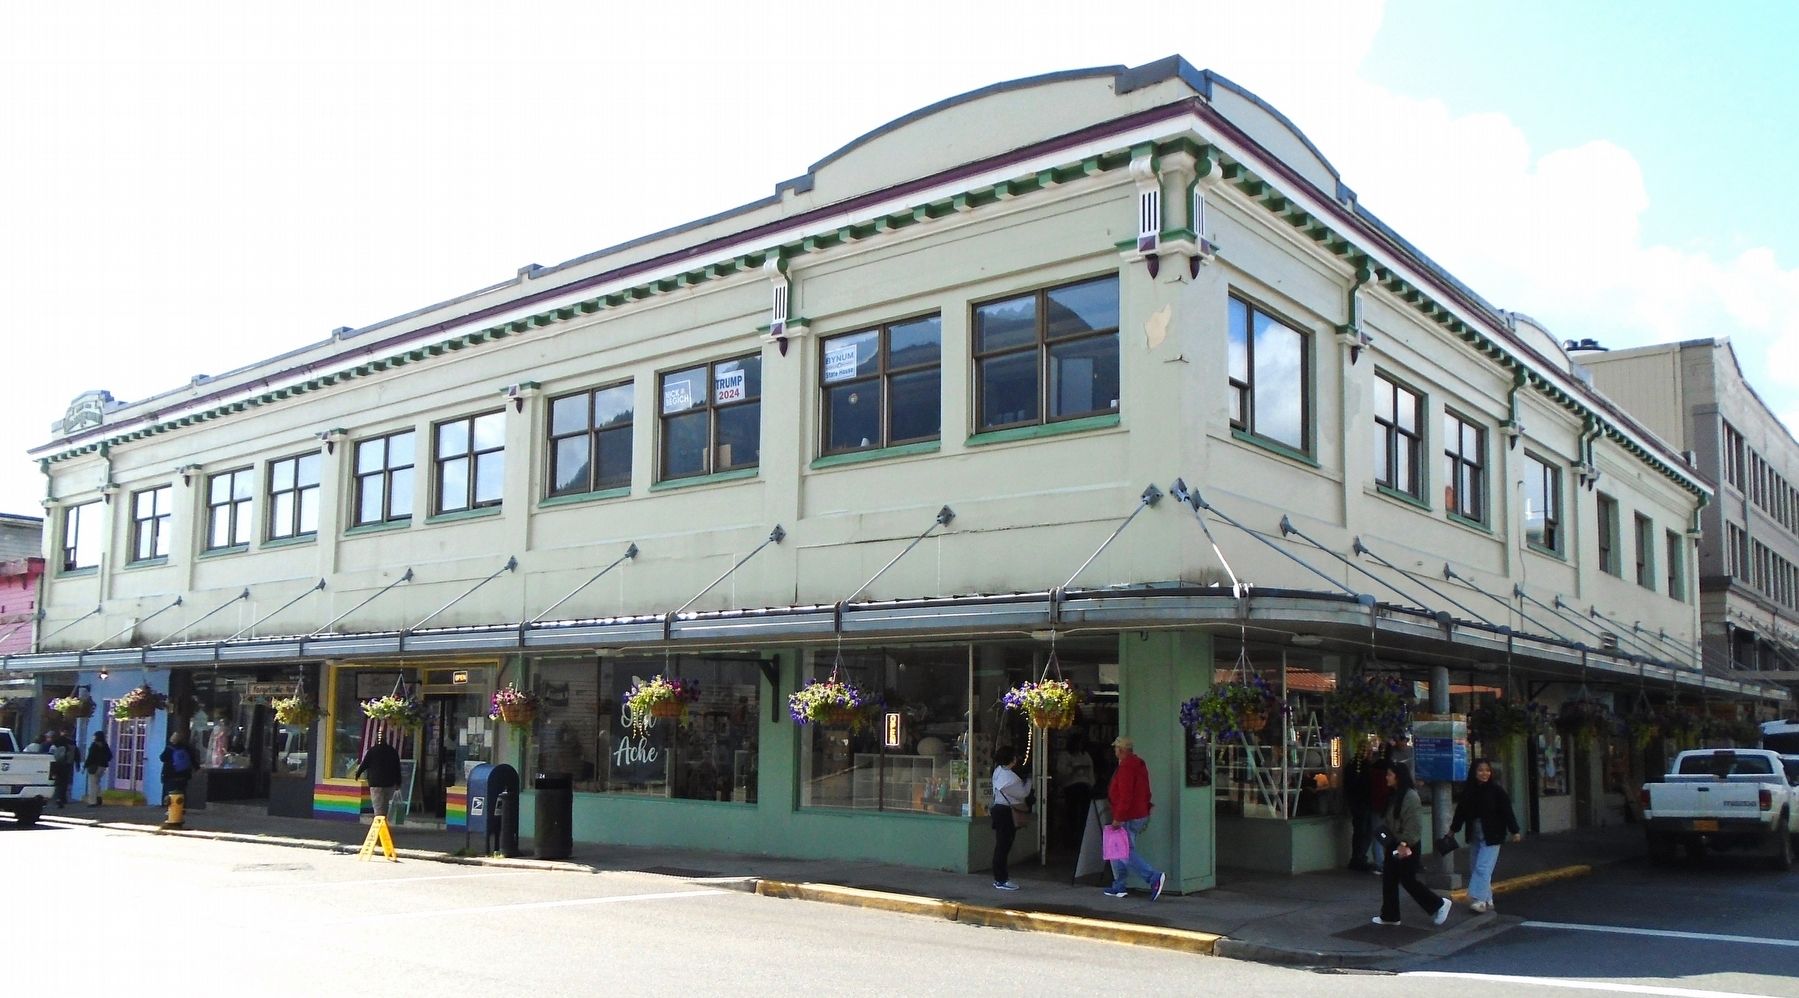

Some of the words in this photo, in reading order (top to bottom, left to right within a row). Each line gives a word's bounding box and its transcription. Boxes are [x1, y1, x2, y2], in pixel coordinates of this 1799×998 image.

[715, 375, 742, 390] TRUMP
[719, 388, 740, 400] 2024
[613, 735, 658, 767] Ache
